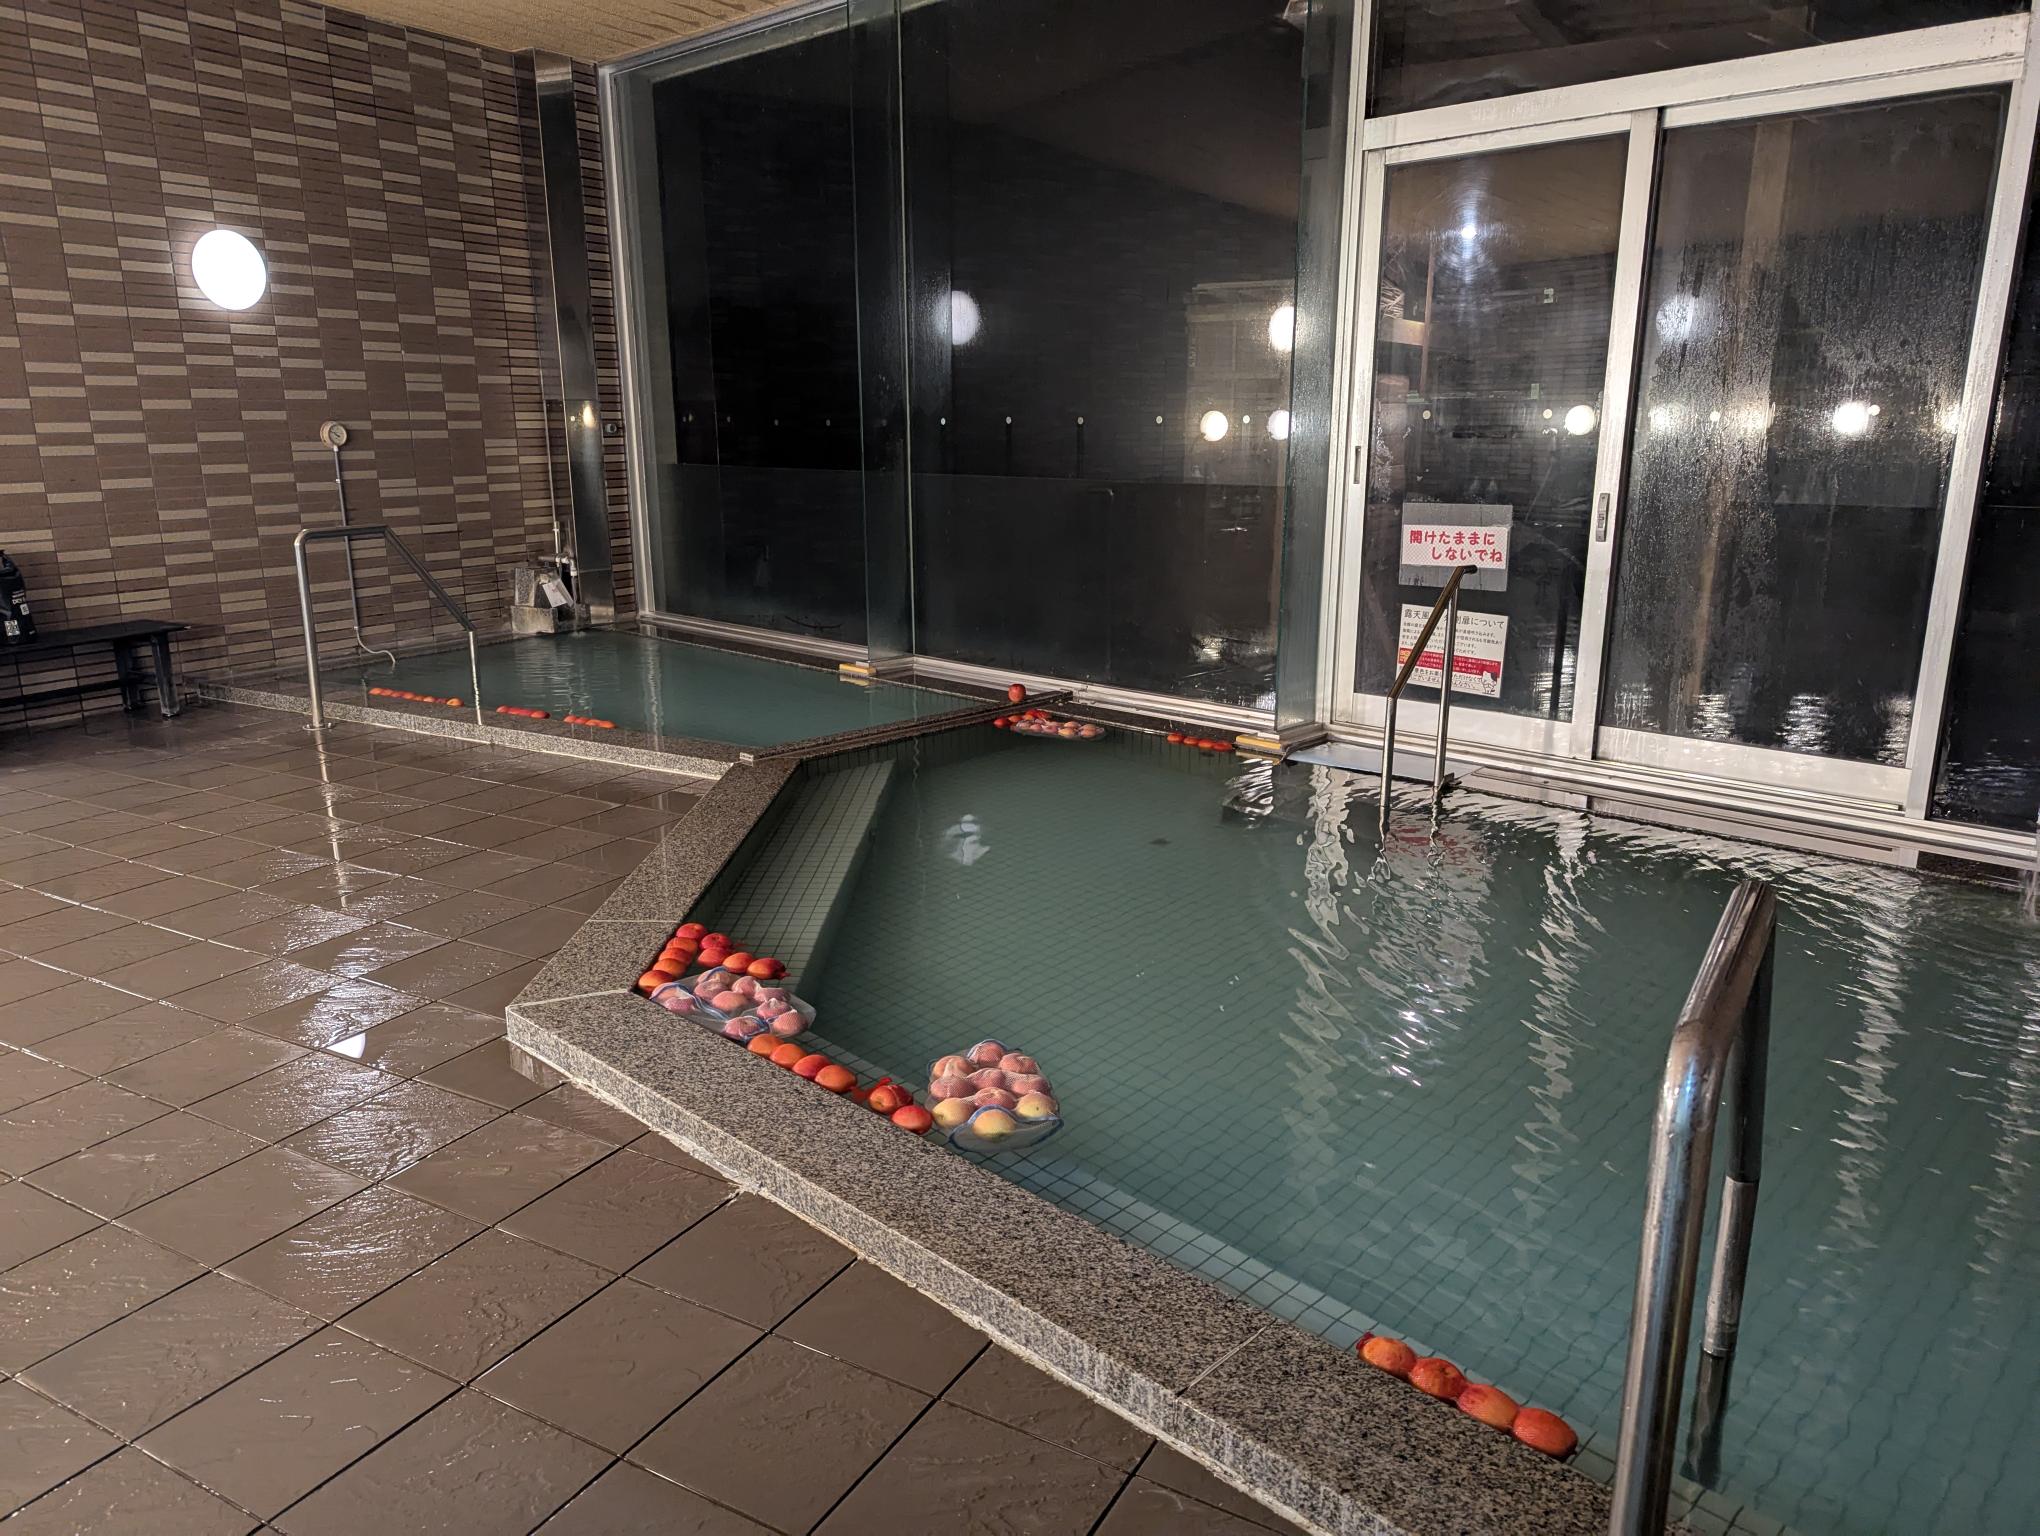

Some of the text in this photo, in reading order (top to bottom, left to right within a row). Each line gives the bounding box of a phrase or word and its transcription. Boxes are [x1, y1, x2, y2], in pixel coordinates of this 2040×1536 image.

[1409, 530, 1496, 546] 開けたままに
[1431, 546, 1503, 563] しないでね
